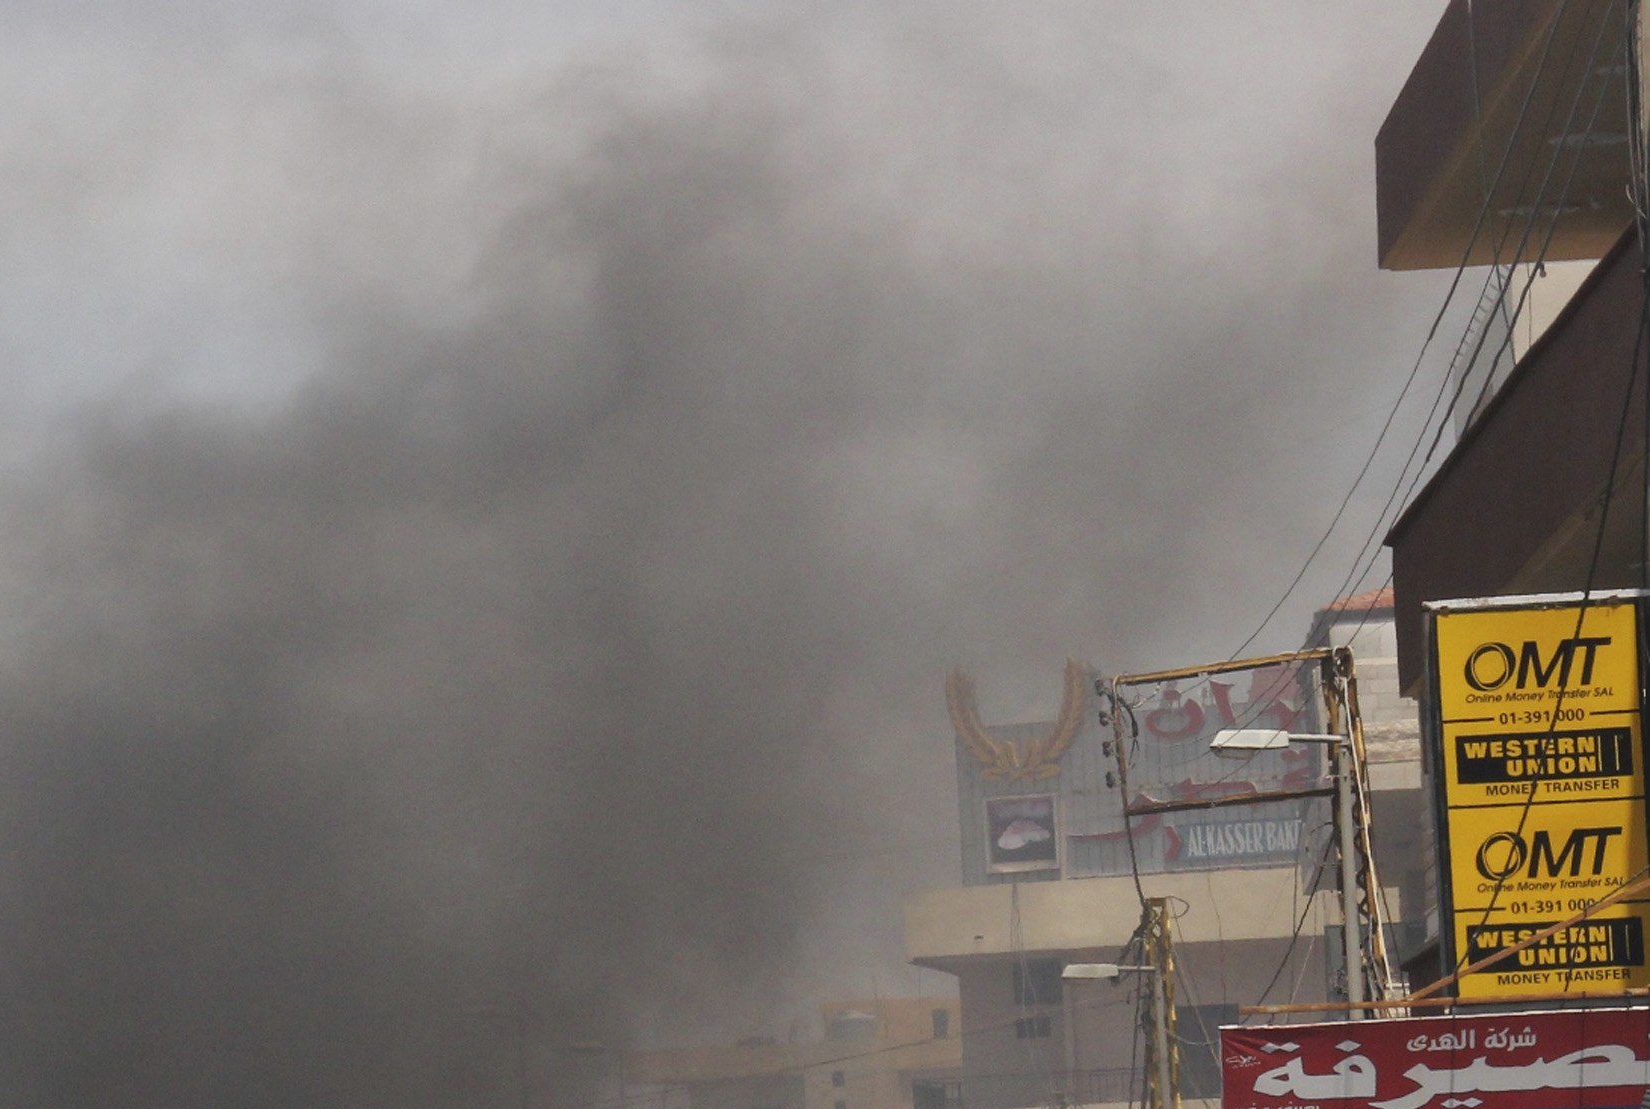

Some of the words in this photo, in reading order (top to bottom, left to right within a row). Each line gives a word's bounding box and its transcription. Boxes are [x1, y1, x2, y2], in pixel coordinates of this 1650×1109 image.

[1464, 637, 1612, 691] OMT
[1465, 693, 1502, 704] Online
[1505, 690, 1544, 704] Money
[1547, 688, 1591, 700] Transfer
[1592, 686, 1614, 697] SAL
[1499, 709, 1550, 724] 01-391
[1464, 736, 1595, 759] WESTERN
[1506, 755, 1597, 777] UNION
[1486, 782, 1539, 796] MONEY
[1544, 779, 1620, 793] TRANSFER
[1476, 826, 1622, 881] OMT
[1477, 882, 1514, 893] Onlne
[1517, 881, 1556, 892] Money
[1560, 879, 1602, 889] Transfer
[1511, 900, 1562, 914] 01-391
[1476, 926, 1607, 949] WESTERN
[1518, 945, 1608, 966] UNION
[1498, 973, 1550, 985] MONEY
[1556, 969, 1631, 982] TRANSFER
[1406, 1028, 1476, 1052] الهدى
[1484, 1026, 1537, 1052] شركة
